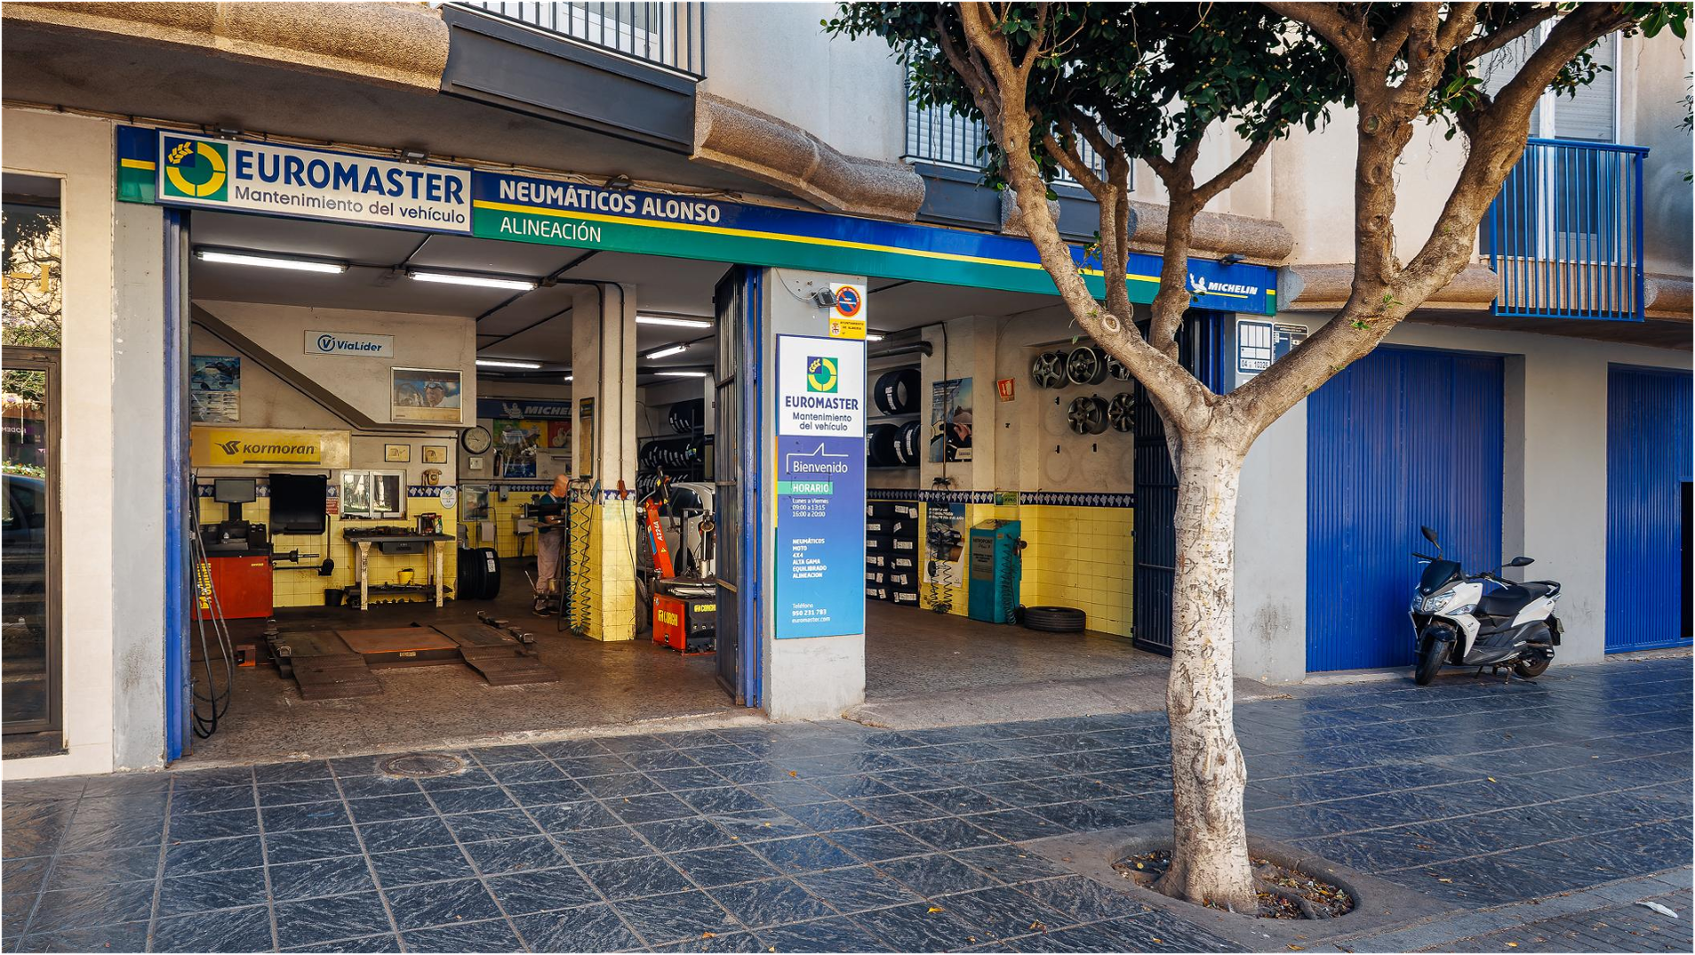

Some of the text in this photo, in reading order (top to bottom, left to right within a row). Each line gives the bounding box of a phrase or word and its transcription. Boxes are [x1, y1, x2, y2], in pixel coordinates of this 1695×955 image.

[235, 151, 465, 205] EUROMASTER
[235, 186, 465, 224] Mantenimiento del vehículo
[500, 179, 720, 223] NEUMÁTICOS ALONSO
[500, 217, 601, 243] ALINEACIÓN
[1208, 282, 1258, 295] MICHELIN
[785, 396, 859, 410] EUROMASTER
[792, 412, 853, 422] Mantenimiento
[799, 421, 848, 431] del vehículo
[243, 444, 315, 454] kormoran
[793, 461, 848, 473] Bienvenido
[793, 484, 830, 493] HORARIO
